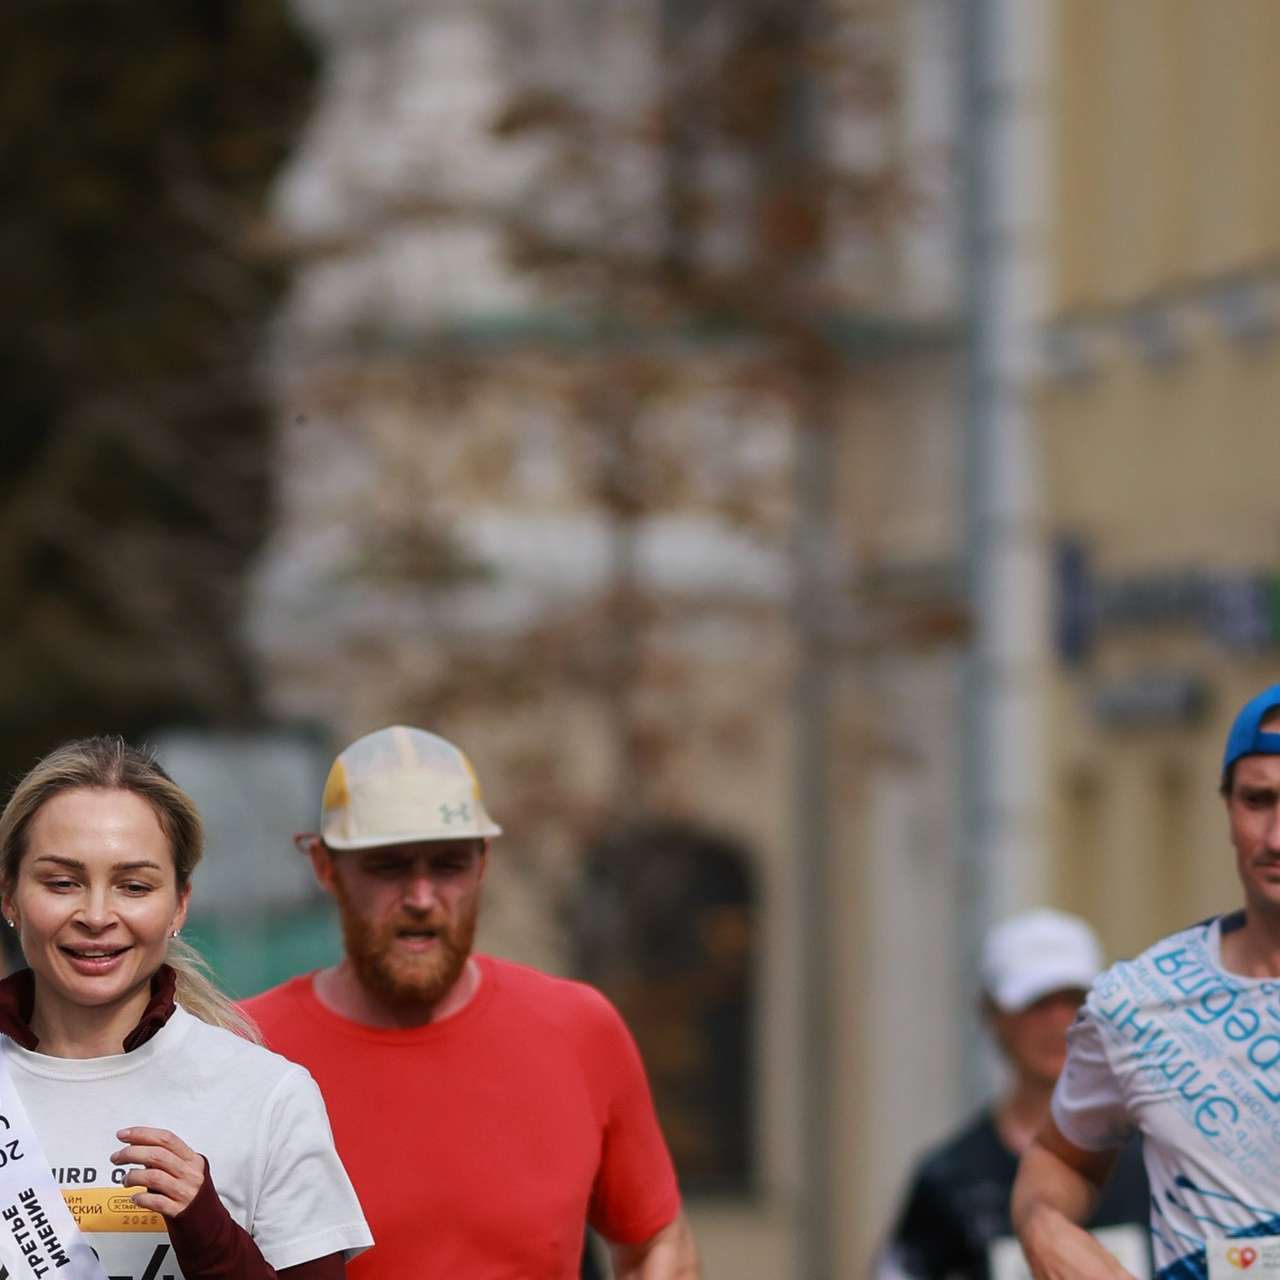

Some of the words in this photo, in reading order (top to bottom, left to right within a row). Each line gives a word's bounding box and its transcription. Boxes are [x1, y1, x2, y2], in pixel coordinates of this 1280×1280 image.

[52, 1167, 97, 1184] IRD
[1, 1205, 49, 1280] ТРЕТЬЕ
[18, 1187, 70, 1269] МНЕНИЕ
[122, 1215, 158, 1225] 2026
